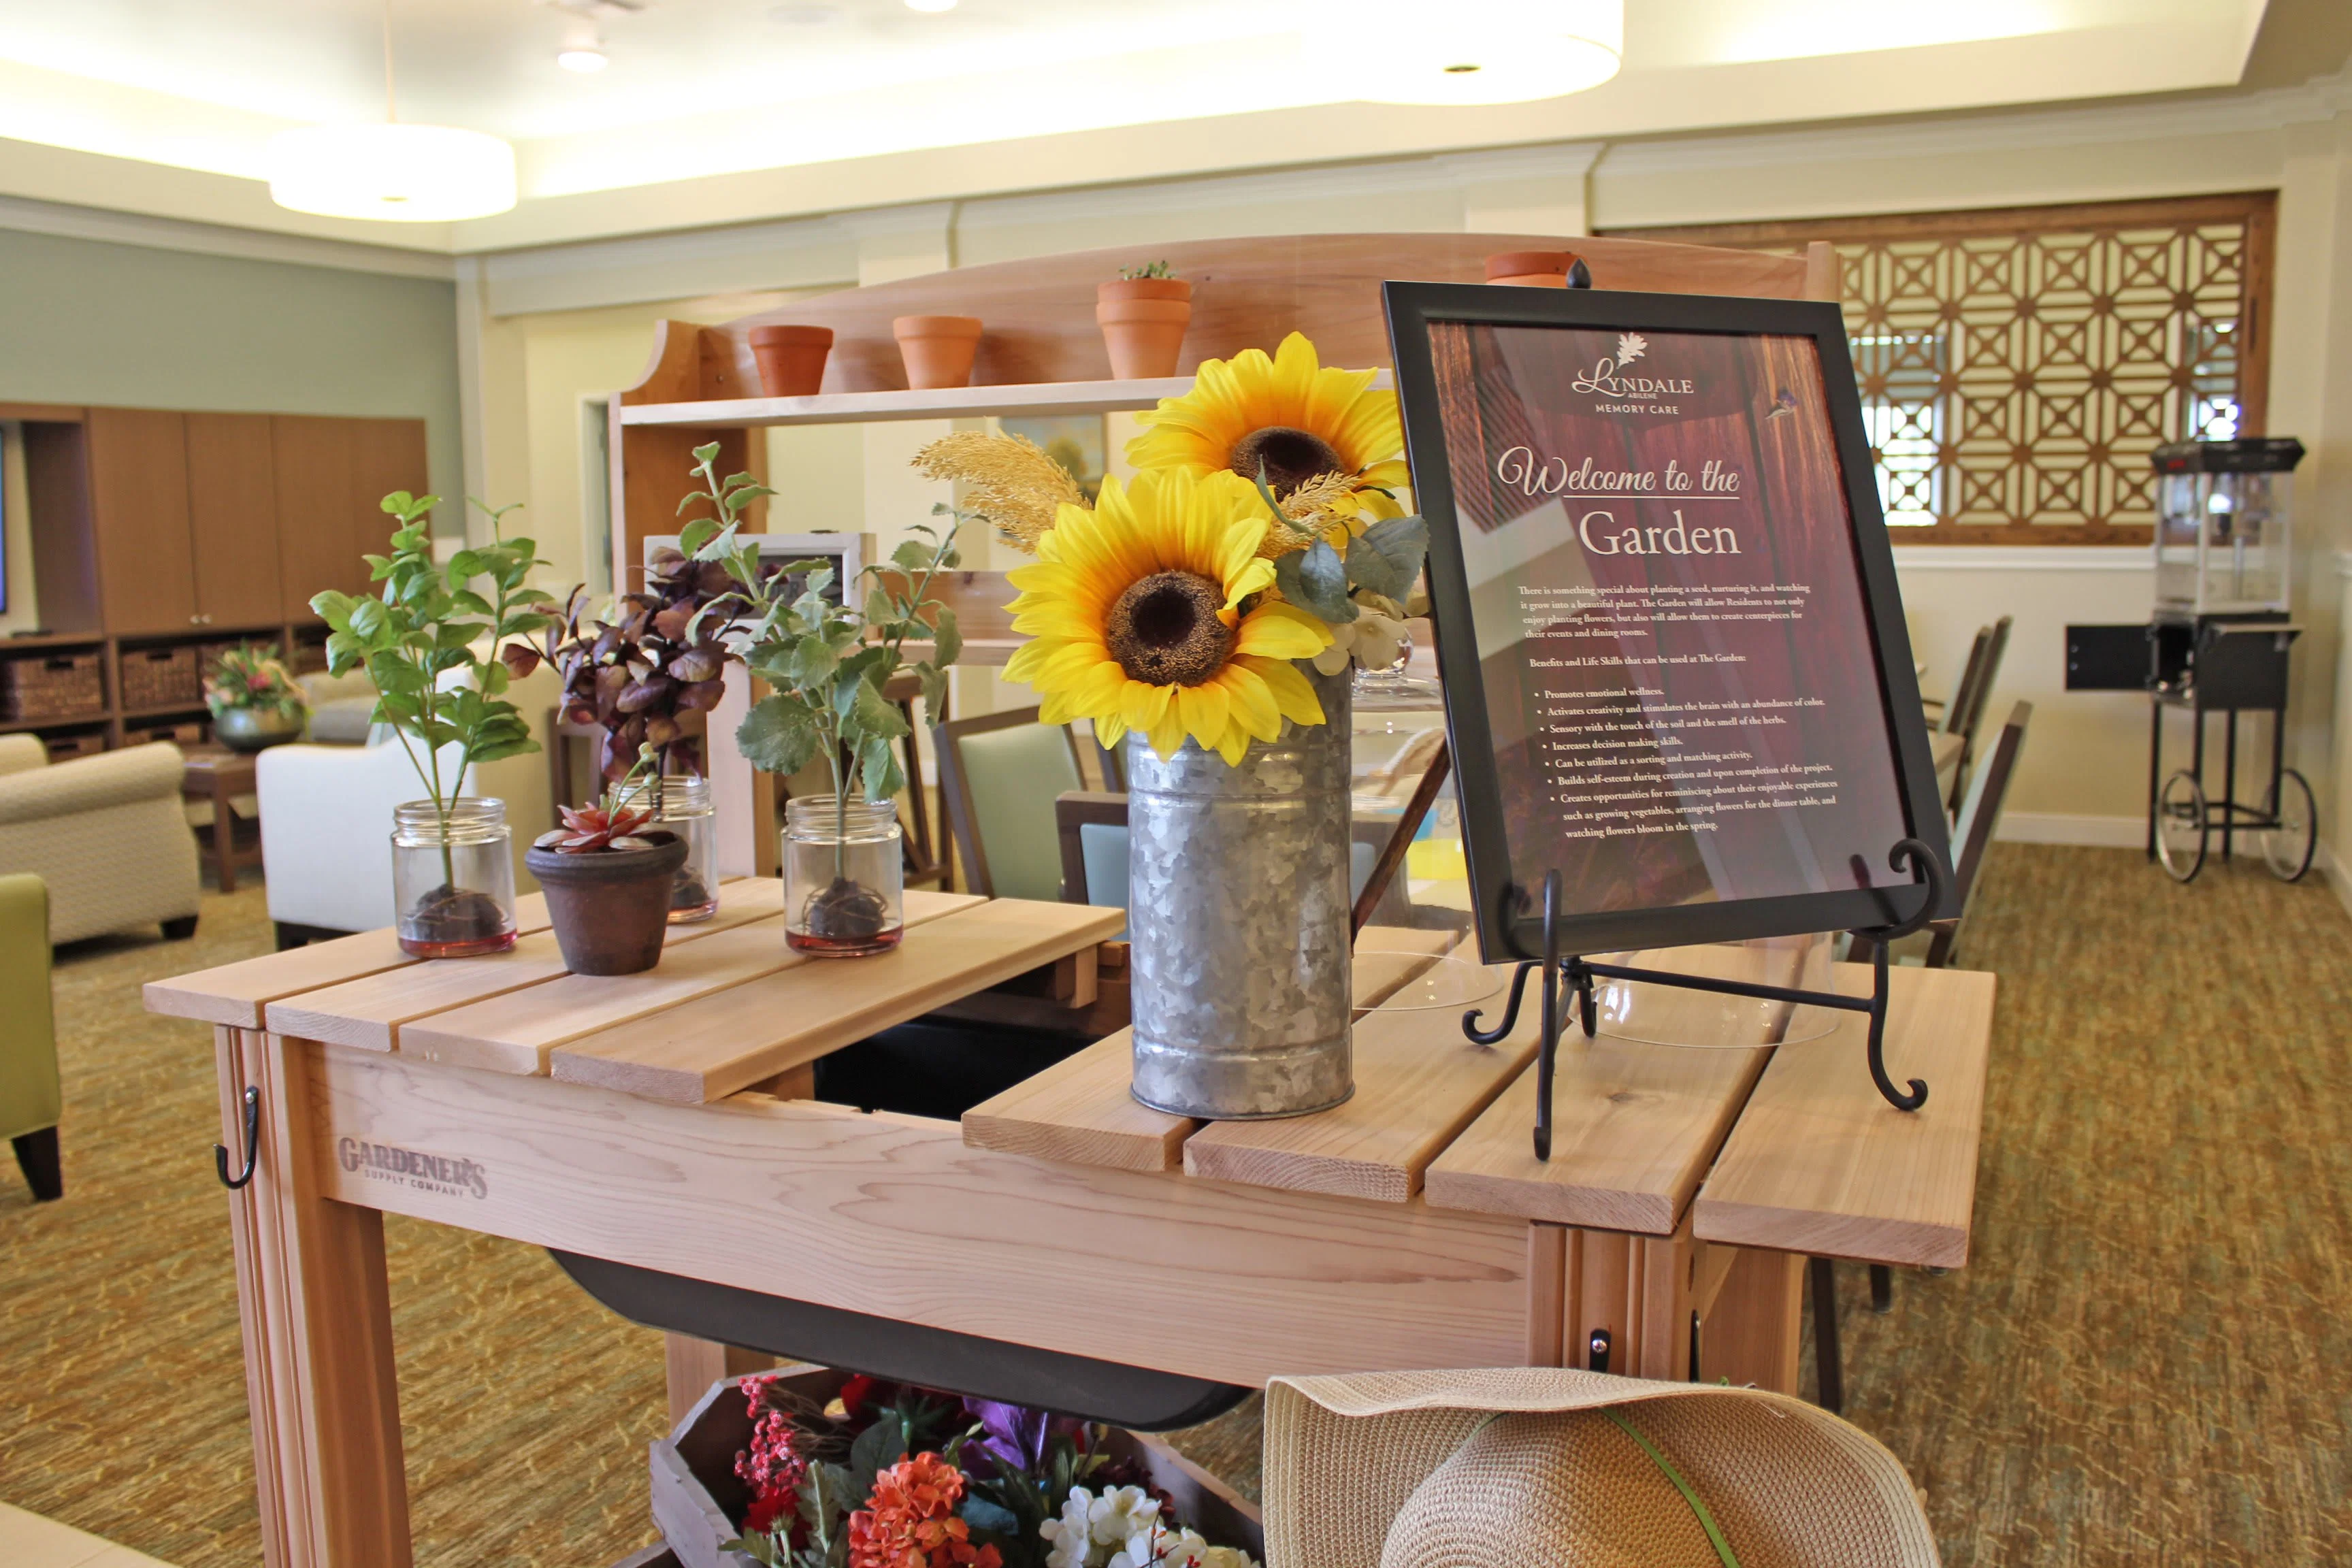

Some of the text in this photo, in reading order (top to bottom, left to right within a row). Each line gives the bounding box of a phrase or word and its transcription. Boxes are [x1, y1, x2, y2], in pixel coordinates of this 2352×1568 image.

[1595, 404, 1679, 414] MEMORY CARE
[1498, 446, 1740, 495] Welcome to the
[1580, 510, 1741, 555] Garden
[1518, 586, 1542, 595] There
[1544, 586, 1551, 594] is
[1552, 585, 1595, 596] something
[1597, 585, 1624, 596] special
[1625, 585, 1648, 593] about
[1650, 585, 1684, 595] planting
[1690, 585, 1710, 593] seed,
[1712, 585, 1750, 594] nurturing
[1761, 584, 1775, 592] and
[1776, 583, 1810, 593] watching
[1529, 603, 1550, 612] grow
[1577, 600, 1614, 608] beautiful
[1640, 599, 1655, 608] The
[1657, 598, 1686, 607] Garden
[1688, 598, 1703, 606] will
[1704, 598, 1725, 606] allow
[1726, 598, 1763, 606] Residents
[1788, 597, 1805, 608] only
[1522, 617, 1546, 625] enjoy
[1548, 615, 1583, 625] planting
[1584, 614, 1616, 623] flowers,
[1616, 613, 1631, 622] but
[1633, 613, 1648, 621] also
[1650, 613, 1665, 621] will
[1667, 612, 1688, 621] allow
[1690, 612, 1710, 621] them
[1745, 612, 1790, 622] centerpieces
[1791, 610, 1802, 619] for
[1525, 630, 1545, 638] their
[1574, 629, 1590, 638] and
[1591, 628, 1619, 638] dining
[1529, 658, 1563, 668] Benefits
[1565, 657, 1580, 666] and
[1582, 657, 1599, 666] Life
[1600, 656, 1622, 666] Skills
[1658, 655, 1668, 664] be
[1670, 655, 1687, 664] used
[1698, 654, 1714, 662] The
[1715, 653, 1746, 662] Garden:
[1544, 687, 1664, 699] Promotes emotional wellness.
[1547, 707, 1585, 717] Activates
[1586, 705, 1624, 716] creativity
[1625, 704, 1641, 713] and
[1643, 703, 1683, 712] stimulates
[1684, 702, 1698, 711] the
[1699, 702, 1720, 710] brain
[1721, 700, 1740, 709] with
[1752, 699, 1794, 708] abundance
[1795, 698, 1803, 706] of
[1550, 724, 1583, 734] Sensory
[1584, 723, 1603, 732] with
[1605, 722, 1619, 731] the
[1620, 721, 1643, 730] touch
[1645, 720, 1654, 729] of
[1655, 719, 1669, 729] the
[1671, 719, 1685, 728] soil
[1686, 718, 1701, 728] and
[1703, 717, 1716, 727] the
[1717, 717, 1737, 726] smell
[1739, 715, 1748, 725] of
[1749, 715, 1762, 725] the
[1552, 742, 1590, 751] Increases
[1592, 740, 1626, 749] decision
[1627, 738, 1659, 748] making
[1554, 759, 1573, 768] Can
[1574, 758, 1586, 767] be
[1586, 757, 1618, 766] utilized
[1637, 755, 1666, 765] sorting
[1667, 753, 1682, 763] and
[1684, 752, 1722, 763] matching
[1558, 777, 1586, 785] Builds
[1586, 774, 1632, 784] self-esteem
[1633, 772, 1661, 783] during
[1662, 771, 1695, 780] creation
[1696, 769, 1712, 778] and
[1714, 769, 1735, 779] upon
[1735, 766, 1779, 777] completion
[1780, 764, 1789, 774] of
[1790, 764, 1803, 773] the
[1560, 781, 1838, 804] Creates opportunities for reminiscing about their enjoyable experiences
[1563, 811, 1583, 821] such
[1595, 809, 1630, 821] growing
[1631, 806, 1674, 819] vegetables,
[1675, 804, 1714, 815] arranging
[1716, 802, 1744, 811] flowers
[1745, 800, 1757, 810] for
[1758, 799, 1771, 808] the
[1772, 798, 1798, 808] dinner
[1822, 795, 1836, 804] and
[1565, 828, 1605, 839] watching
[1606, 826, 1636, 836] flowers
[1637, 824, 1663, 834] bloom
[1665, 823, 1674, 832] in
[1676, 822, 1689, 832] the
[338, 1137, 488, 1199] GARDENER'S
[365, 1169, 464, 1197] SUPPLY COMPANY
